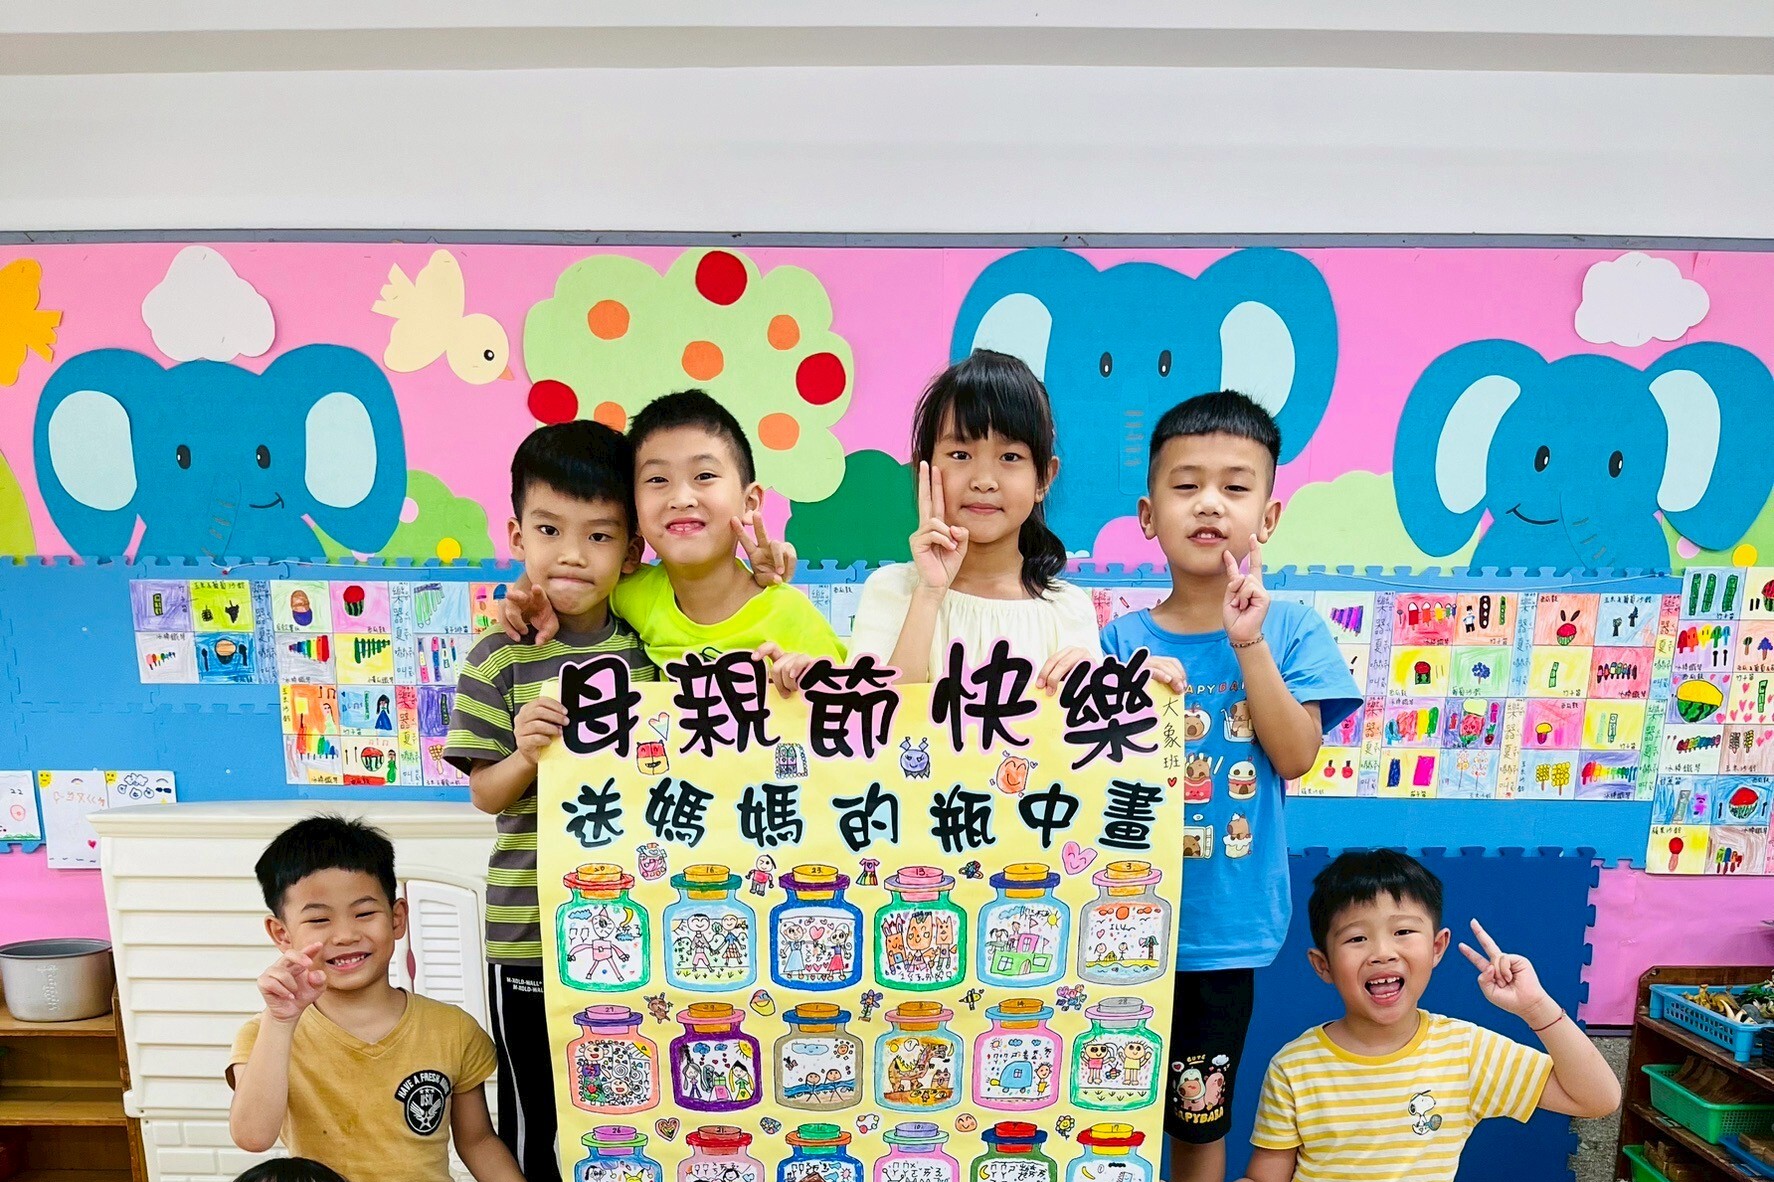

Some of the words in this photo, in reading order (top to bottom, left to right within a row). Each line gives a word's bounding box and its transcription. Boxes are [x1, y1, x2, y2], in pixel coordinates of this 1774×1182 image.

[560, 640, 1160, 770] 母親節快樂
[1163, 697, 1181, 770] 大象班
[561, 780, 1163, 852] 送媽媽的瓶中畫
[397, 1078, 414, 1099] HAVE
